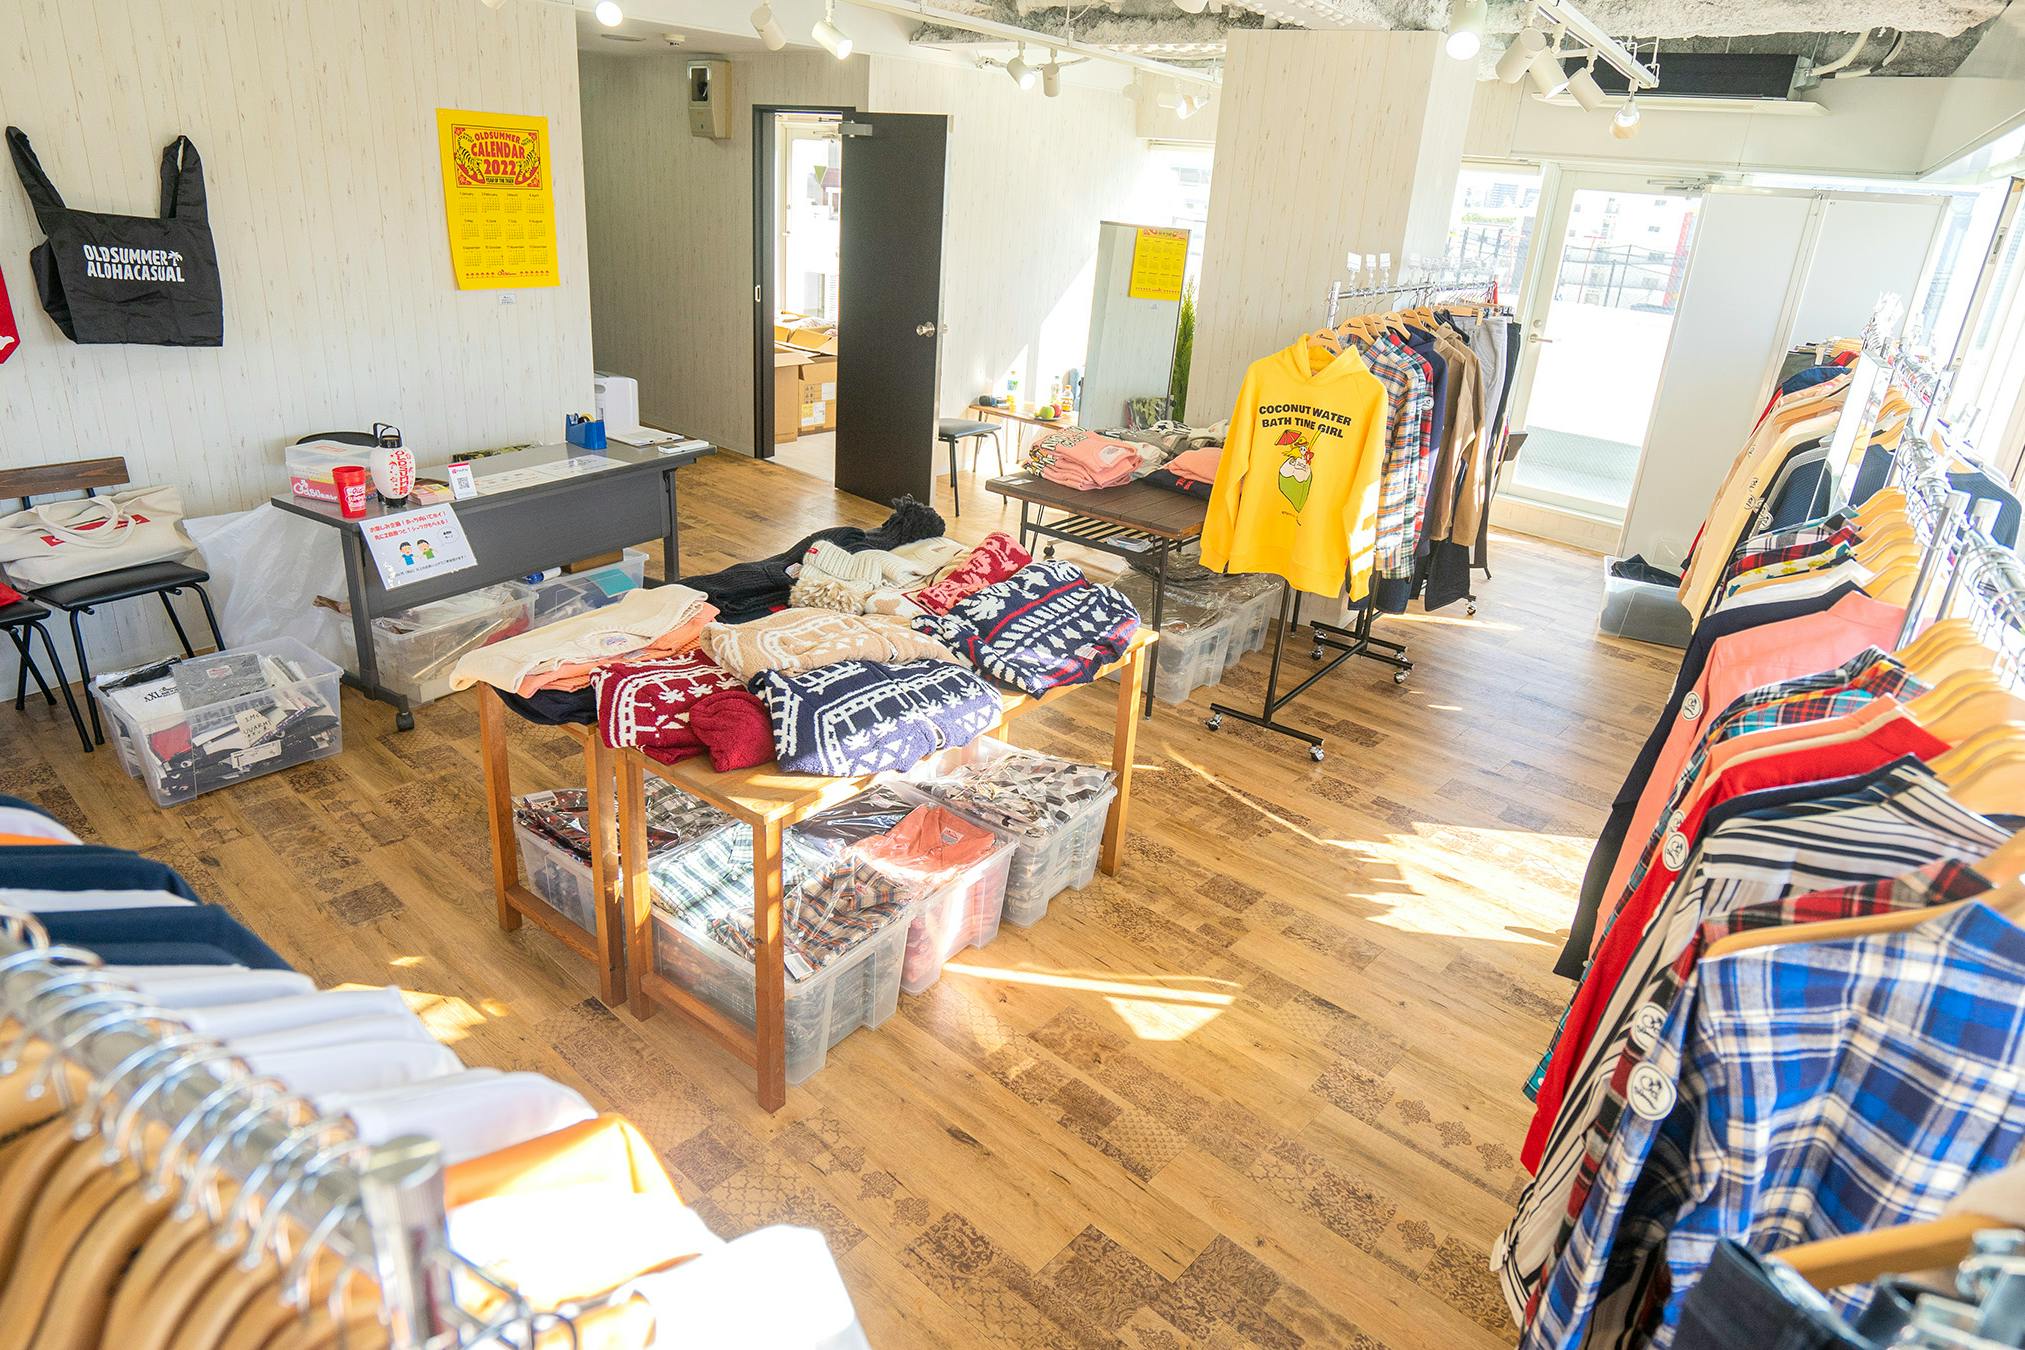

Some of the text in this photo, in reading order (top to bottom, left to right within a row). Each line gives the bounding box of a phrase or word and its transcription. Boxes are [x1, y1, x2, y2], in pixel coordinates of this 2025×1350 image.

[474, 131, 521, 143] OLDSUMMER
[470, 141, 525, 159] CALENDAR
[484, 159, 517, 176] 2022
[83, 244, 168, 266] OLDSUMMER
[87, 261, 185, 282] ALOHACASUAL
[1259, 404, 1352, 426] COCONUT WATER
[1262, 417, 1292, 428] BATH
[1318, 423, 1344, 438] GIRL
